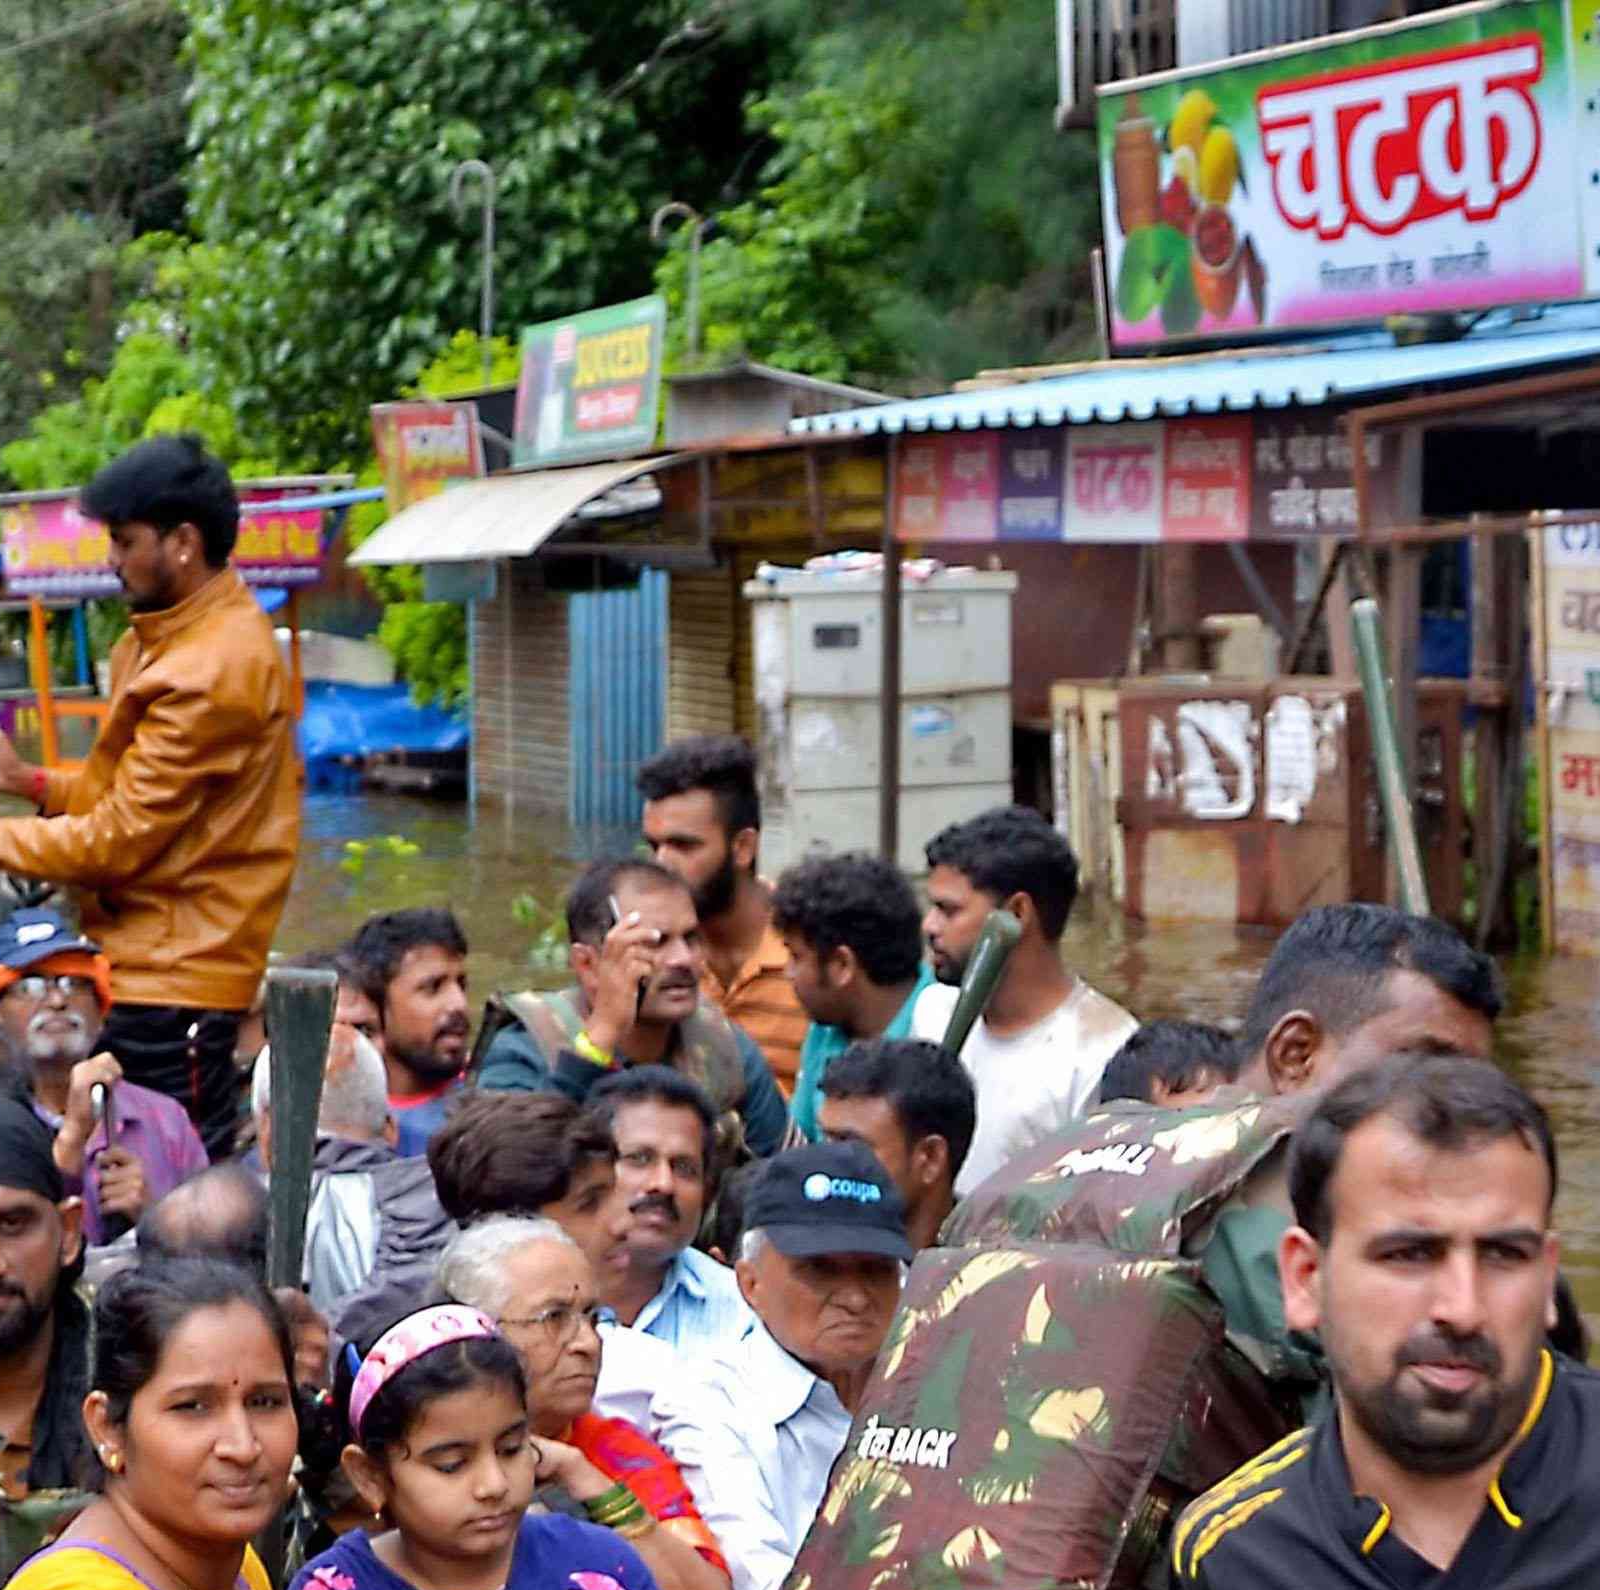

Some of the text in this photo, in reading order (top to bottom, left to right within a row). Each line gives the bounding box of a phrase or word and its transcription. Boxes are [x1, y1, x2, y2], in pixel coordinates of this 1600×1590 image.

[1257, 34, 1542, 240] चटक
[1072, 444, 1156, 516] चटक
[831, 1178, 881, 1203] coupa
[889, 1427, 957, 1468] BACK
